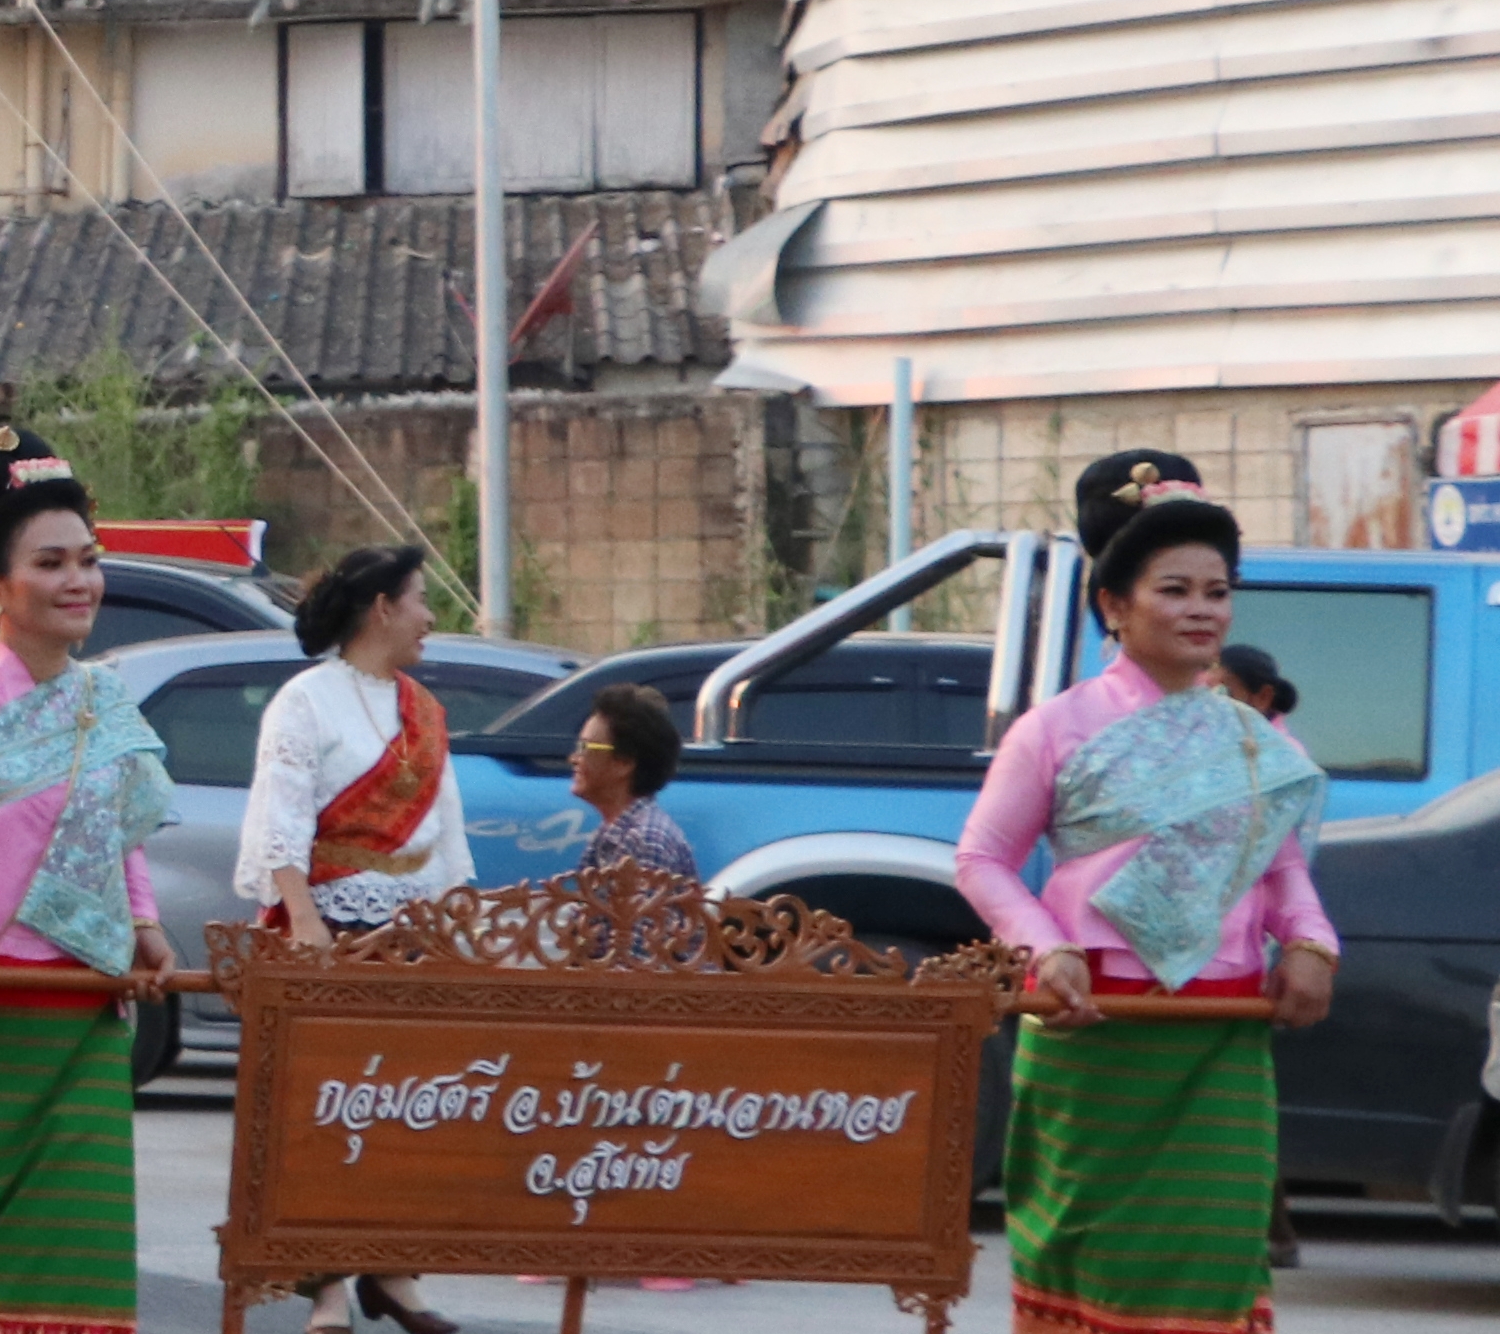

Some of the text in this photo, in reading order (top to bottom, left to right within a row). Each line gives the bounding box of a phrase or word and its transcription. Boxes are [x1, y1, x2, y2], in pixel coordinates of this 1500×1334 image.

[313, 1054, 914, 1165] กลุ่มสตรี อ.บ้านด่านลานหอย
[526, 1140, 692, 1226] จ.สุโขทัย
